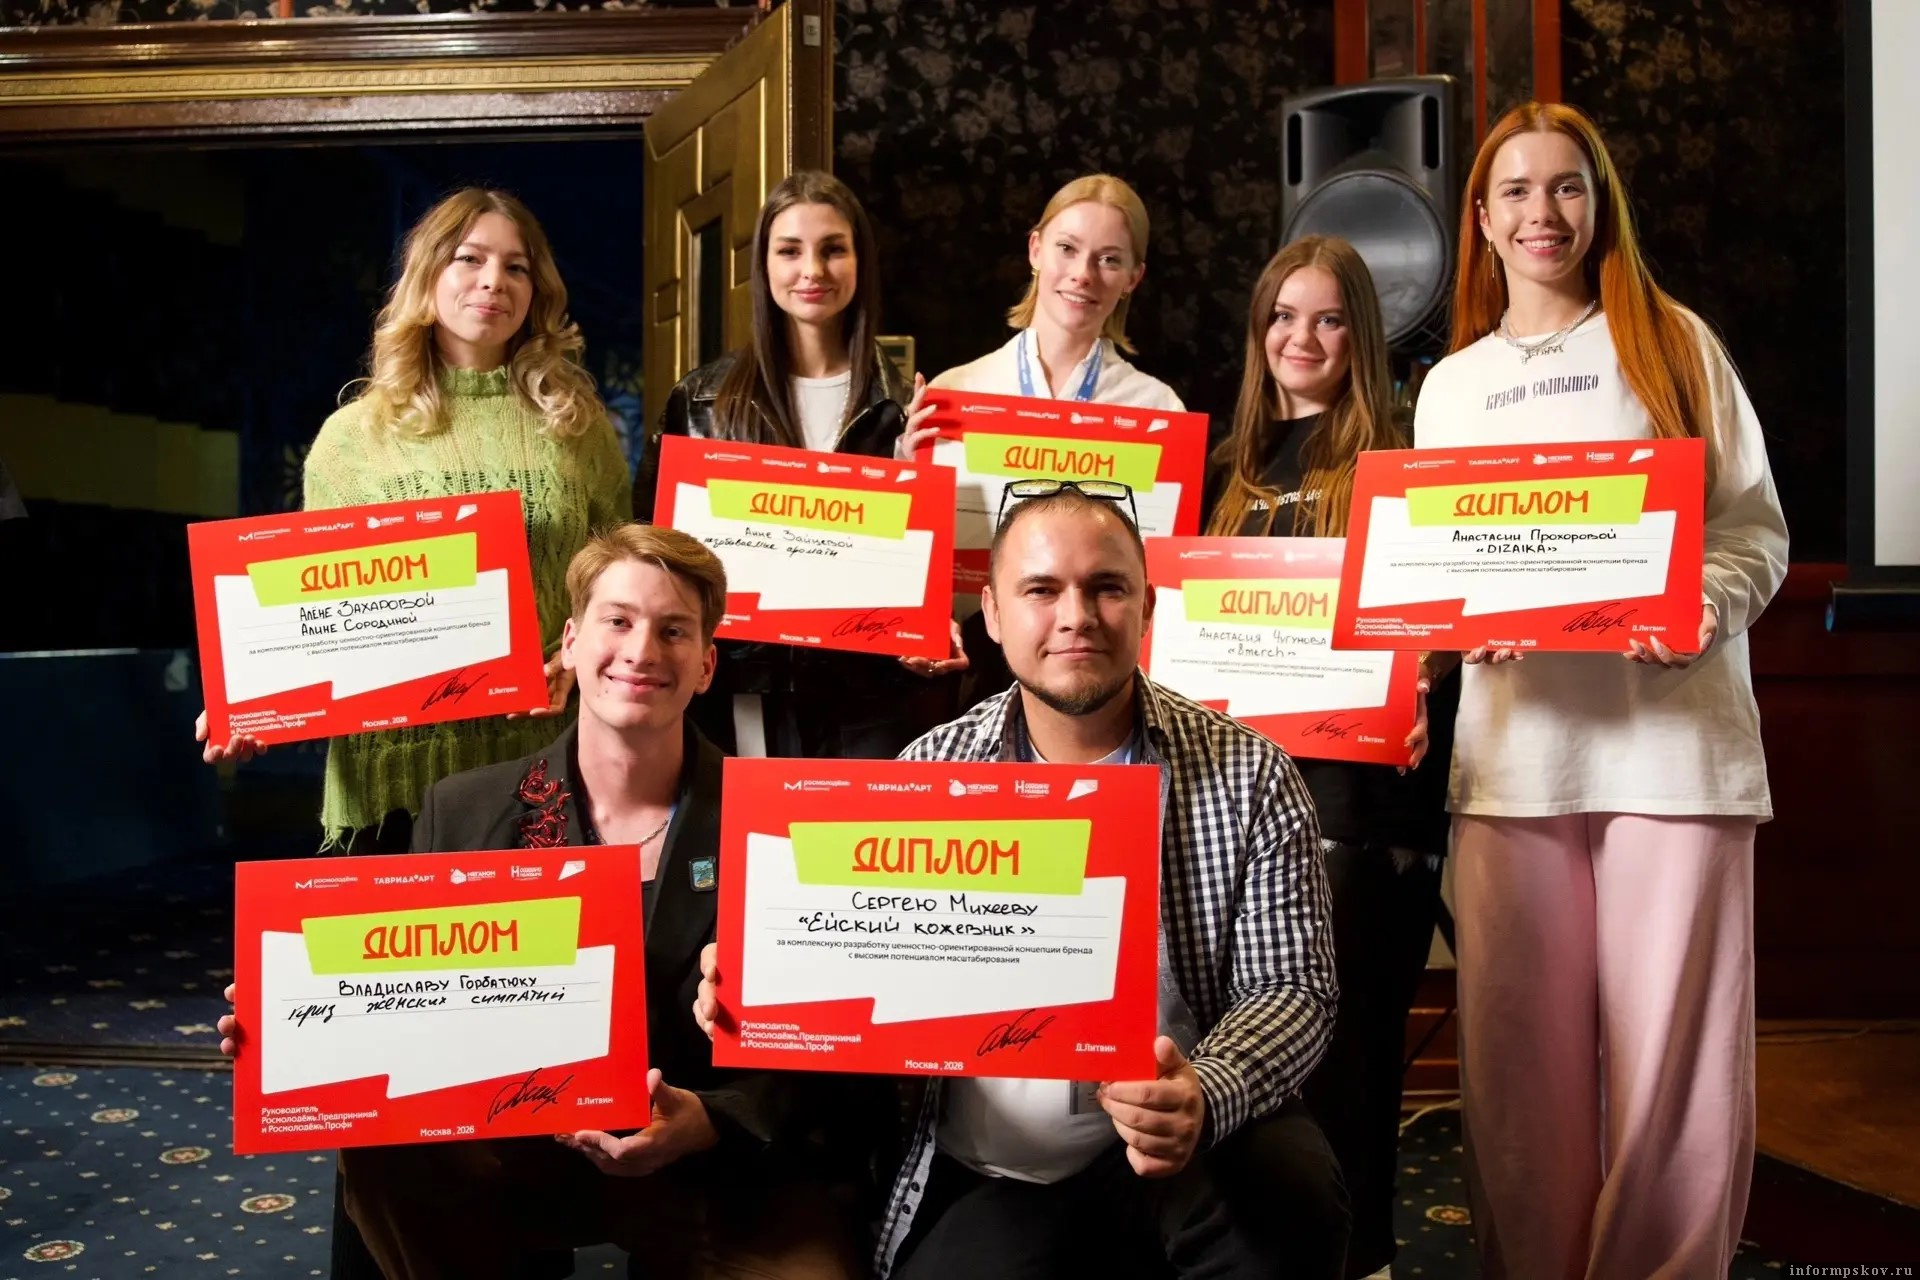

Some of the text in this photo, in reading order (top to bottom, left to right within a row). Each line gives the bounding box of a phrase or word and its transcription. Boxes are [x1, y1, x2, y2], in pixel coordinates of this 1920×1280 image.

[1486, 374, 1599, 410] КРАСНО СОЛНЫШКО
[1003, 445, 1115, 478] ДИПЛОМ
[750, 492, 864, 524] ДИПЛОМ
[1453, 490, 1589, 517] ДИПЛОМ
[301, 553, 428, 592] ДИПЛОМ
[1219, 590, 1328, 617] ДИПЛОМ
[852, 837, 1019, 876] ДИПЛОМ
[362, 919, 519, 959] ДИПЛОМ
[787, 939, 842, 948] комплексную
[843, 940, 889, 950] разработку
[891, 943, 1014, 953] ценностно-ориентированной
[1015, 946, 1061, 954] концепции
[1062, 945, 1093, 955] бренда
[854, 952, 889, 960] высоким
[890, 953, 946, 962] потенциалом
[946, 955, 1020, 964] масштабирования
[741, 1020, 800, 1031] Руководитель
[1075, 1043, 1116, 1053] Д.Литвин
[905, 1059, 939, 1070] Москва
[944, 1061, 964, 1071] 2026
[261, 1106, 319, 1116] Руководитель
[576, 1096, 614, 1107] Д.Литвин
[420, 1127, 452, 1137] Москва
[457, 1126, 475, 1135] 2026
